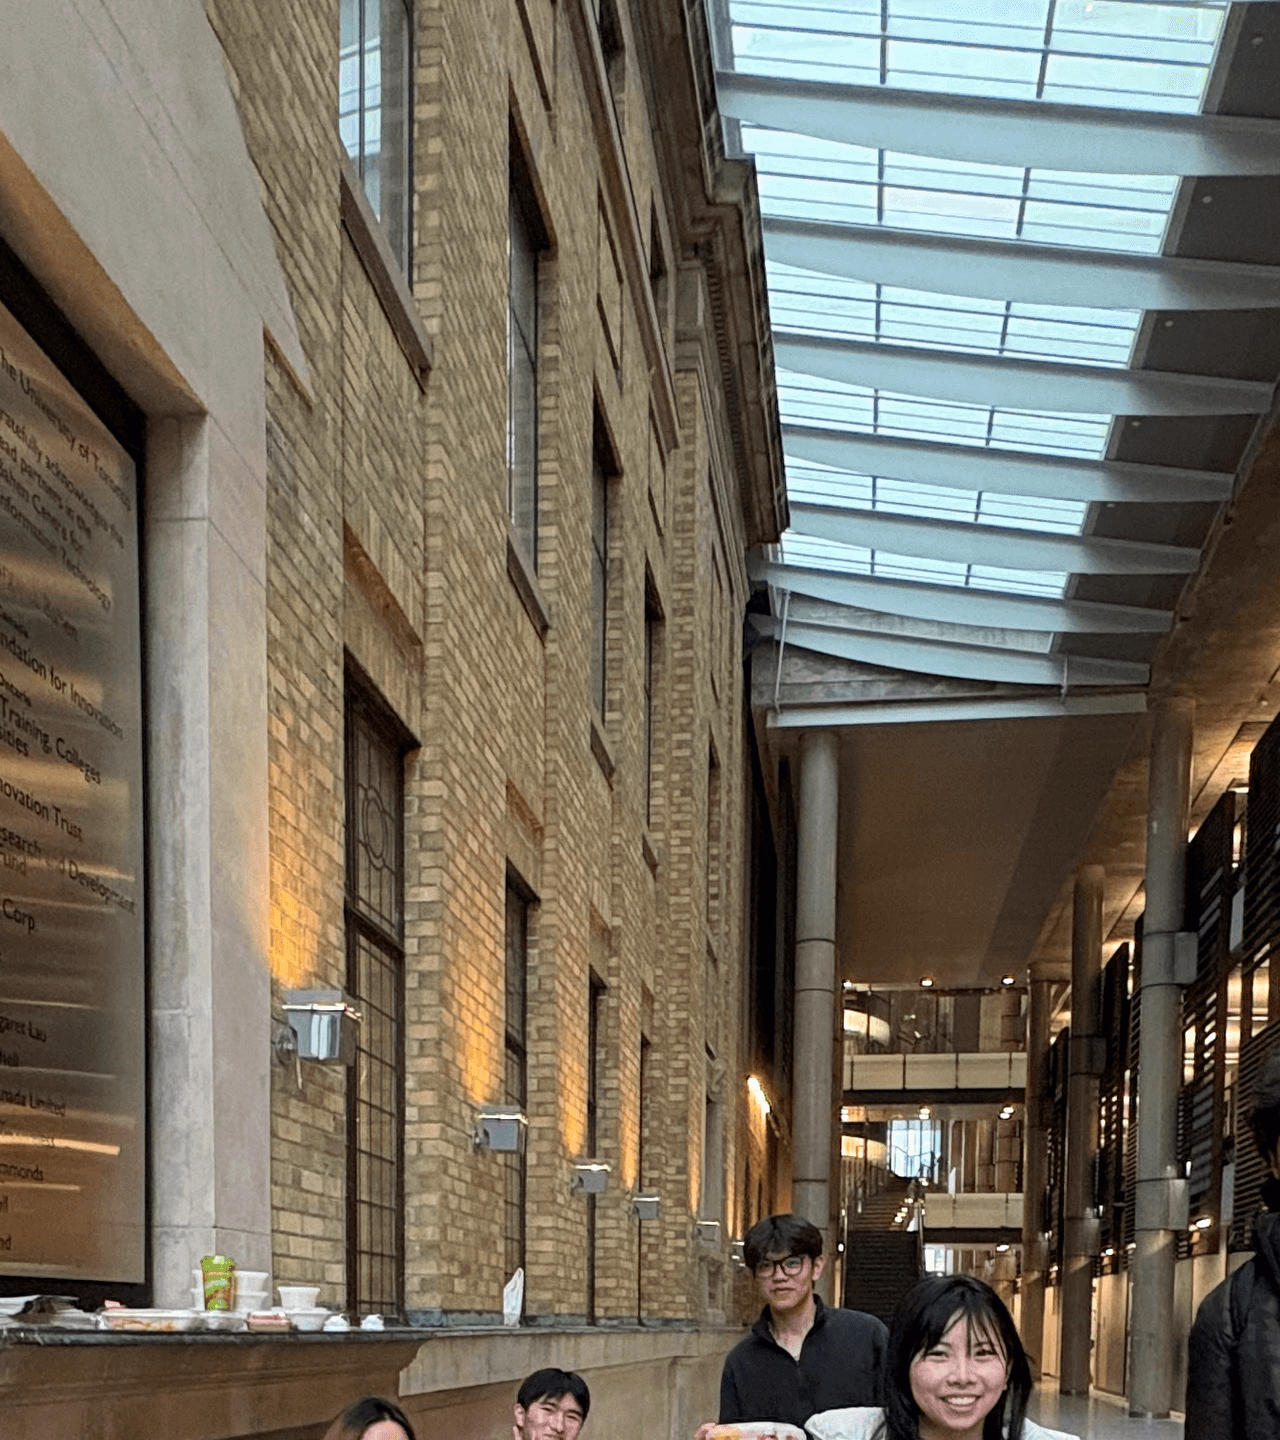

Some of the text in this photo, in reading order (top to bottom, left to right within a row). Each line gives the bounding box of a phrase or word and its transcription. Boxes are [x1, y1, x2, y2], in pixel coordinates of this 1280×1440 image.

[20, 370, 77, 451] University
[78, 443, 89, 463] of
[91, 451, 132, 511] Toronto
[20, 456, 64, 510] partners
[60, 545, 111, 613] Technology
[50, 666, 68, 695] for
[70, 682, 123, 741] Innovation
[56, 736, 101, 785] Colleges
[52, 804, 84, 842] Trust
[69, 859, 136, 916] Development
[29, 1091, 66, 1117] Limited
